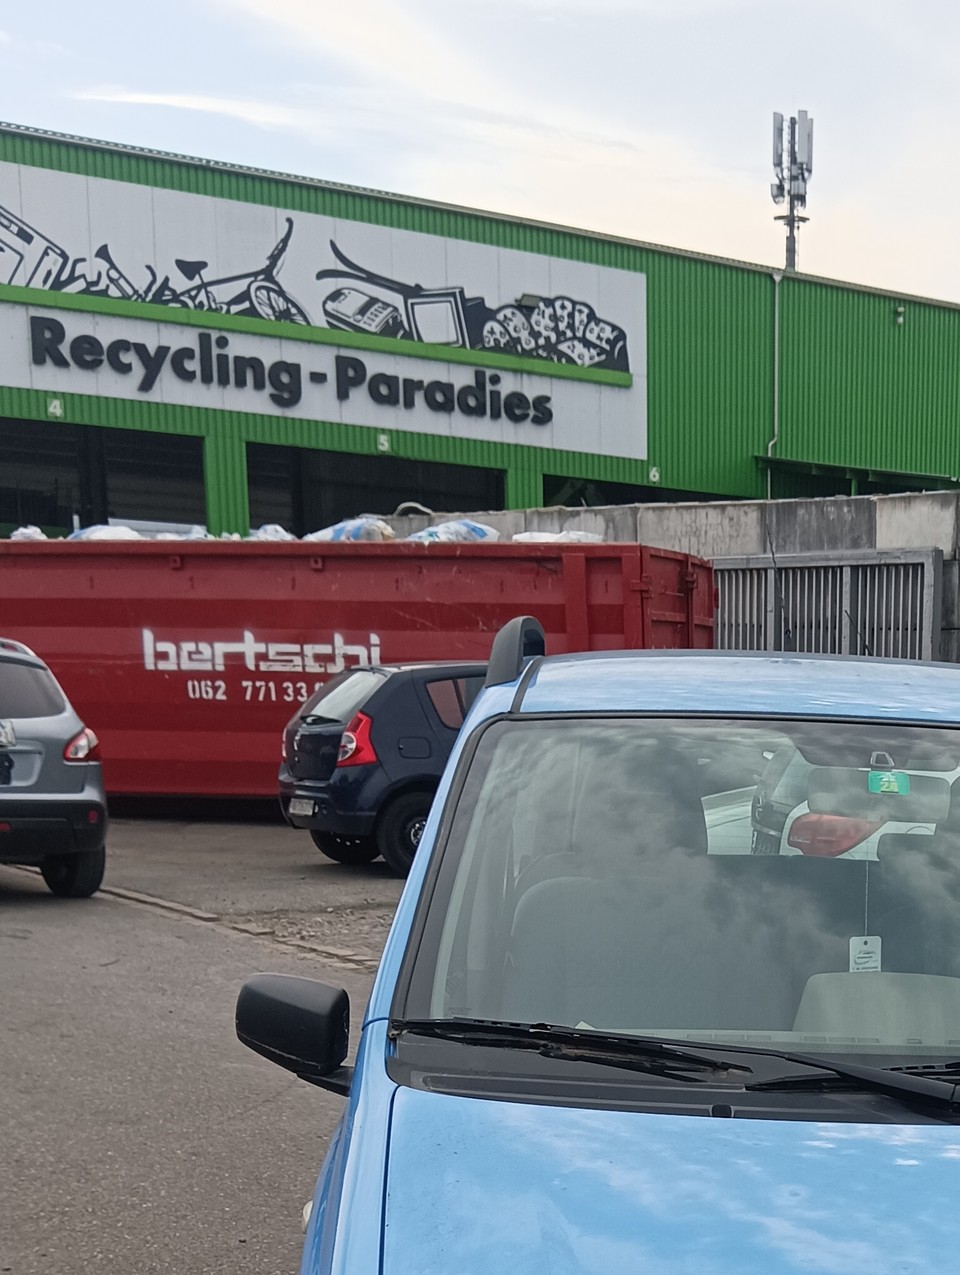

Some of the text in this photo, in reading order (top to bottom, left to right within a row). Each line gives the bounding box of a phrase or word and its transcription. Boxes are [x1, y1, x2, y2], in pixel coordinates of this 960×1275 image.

[48, 399, 63, 417] 4
[378, 434, 390, 451] 5
[649, 466, 660, 481] 6
[142, 628, 381, 673] bertschi
[187, 679, 228, 701] 062
[241, 681, 277, 702] 771
